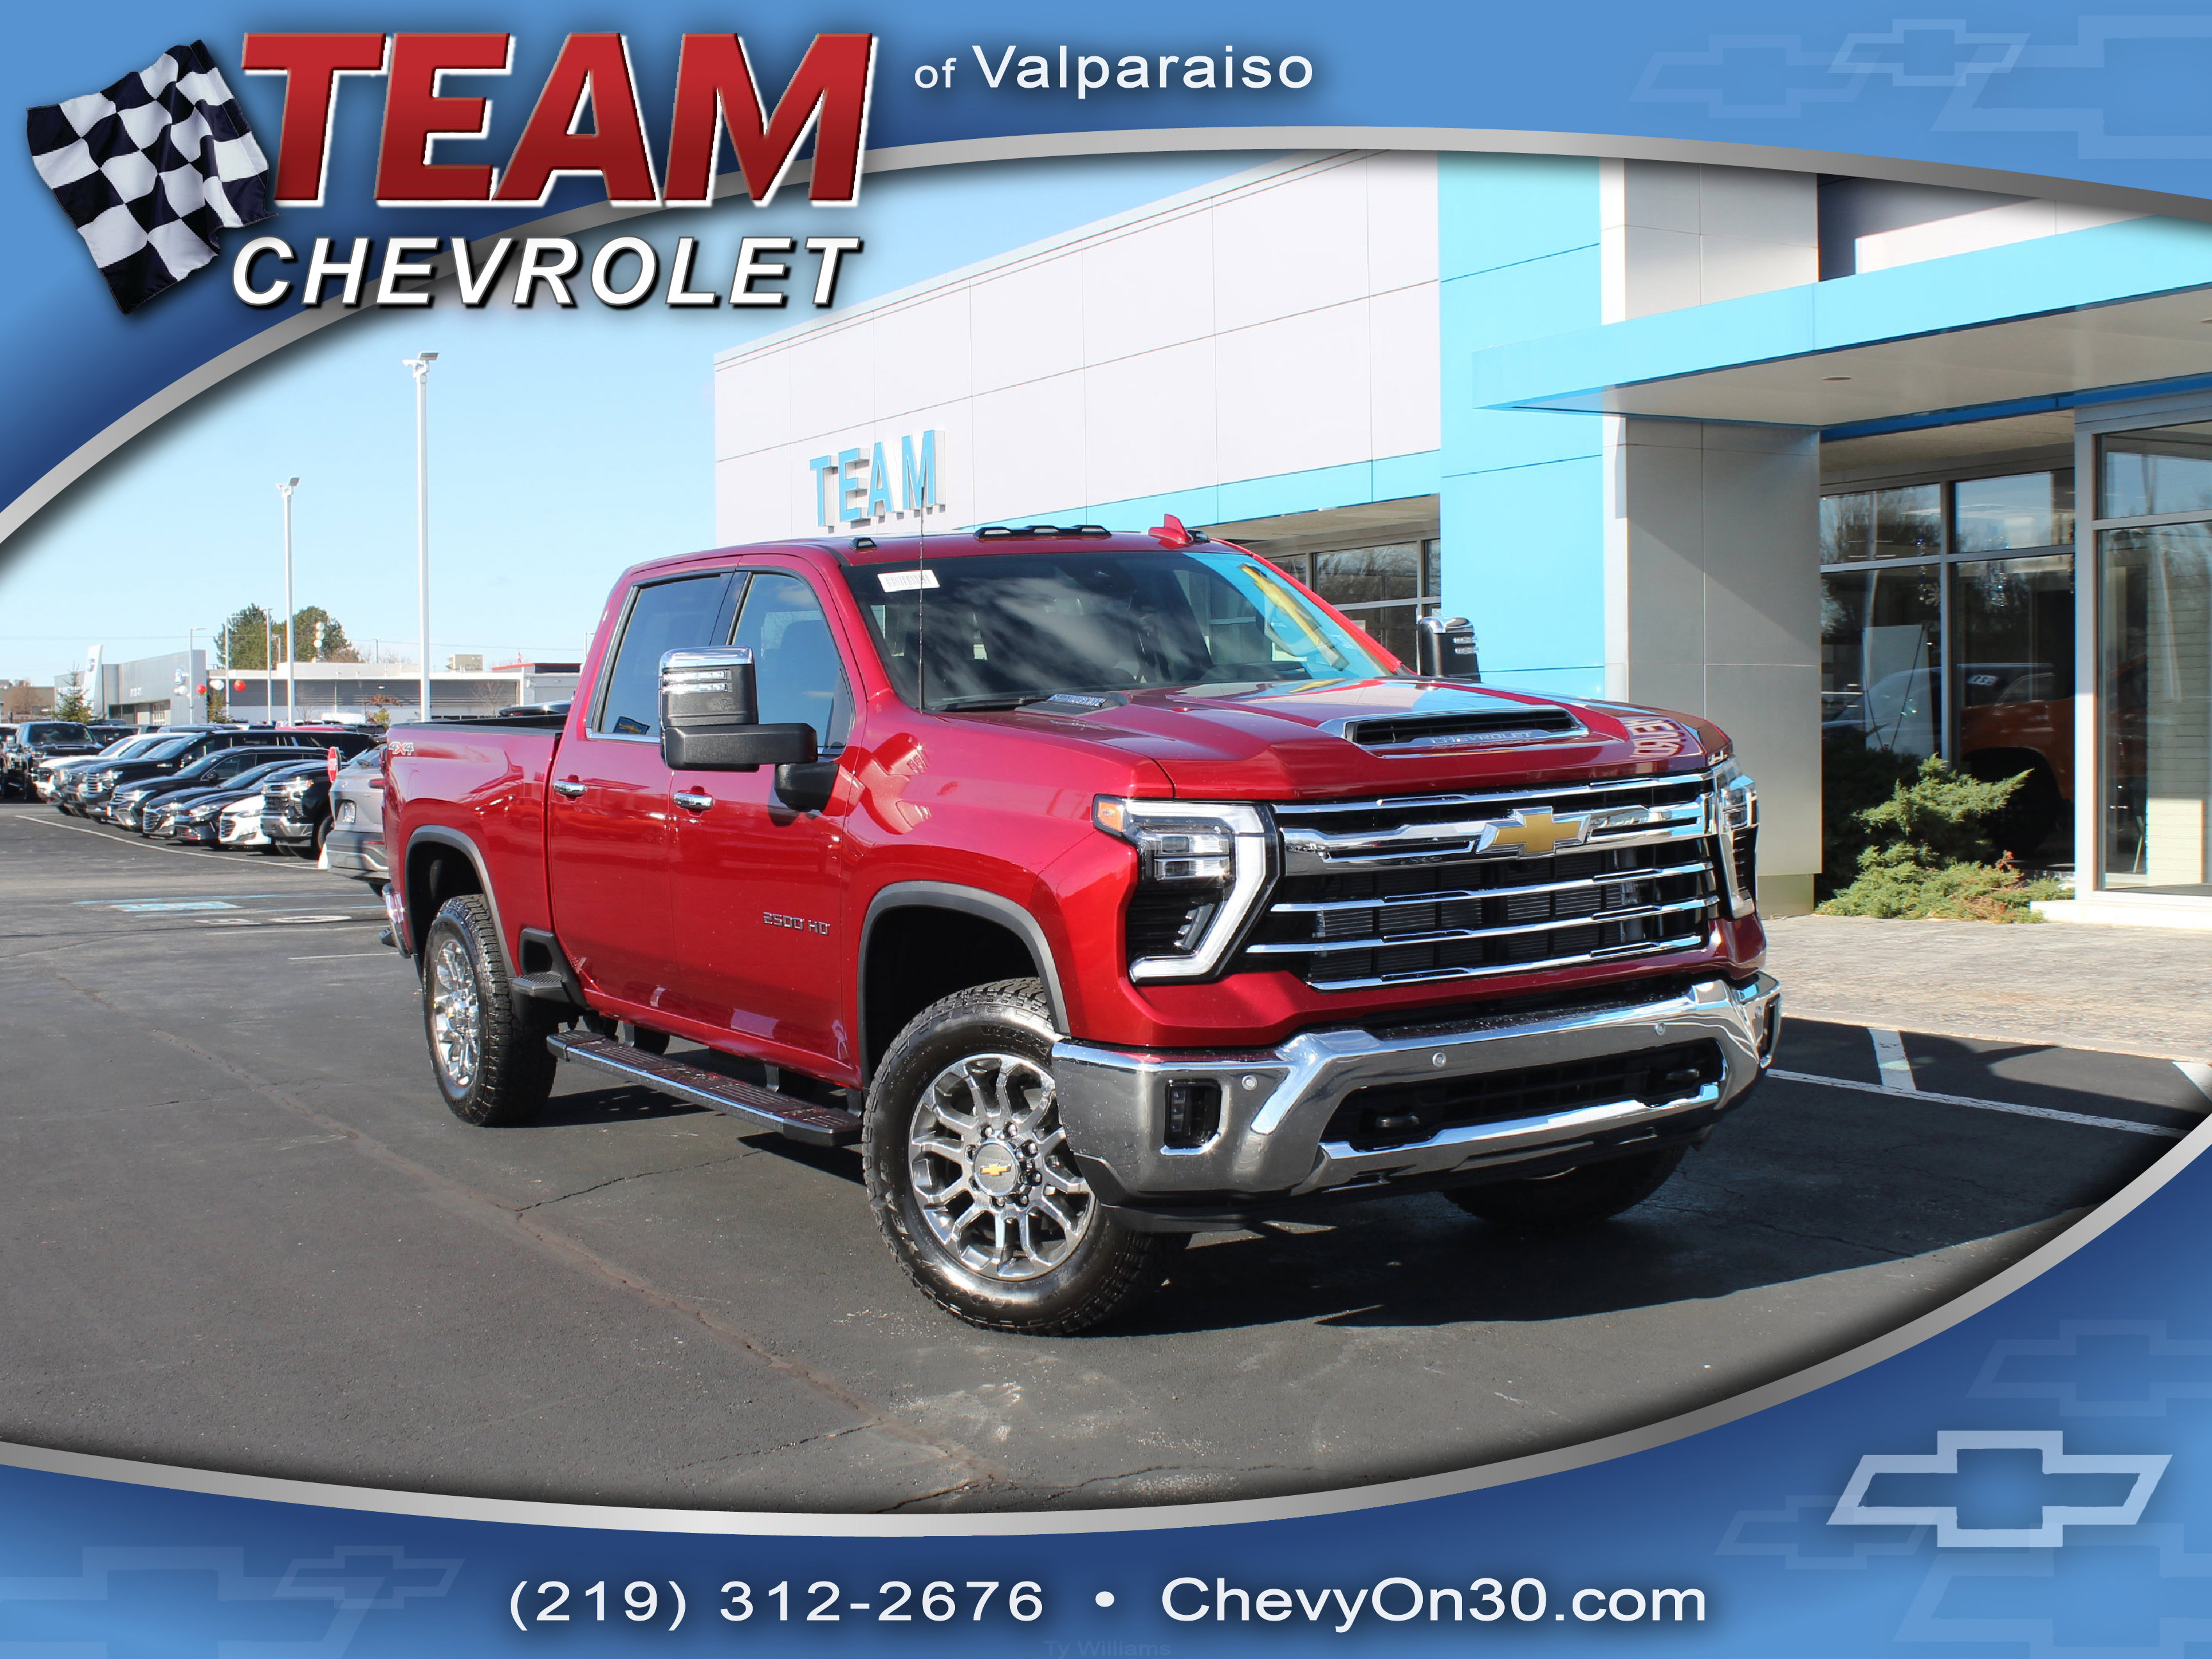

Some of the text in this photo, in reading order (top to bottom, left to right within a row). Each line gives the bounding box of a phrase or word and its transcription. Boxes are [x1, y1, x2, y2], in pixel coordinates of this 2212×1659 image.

[810, 429, 946, 527] TEAM
[763, 911, 831, 936] 2500 HD
